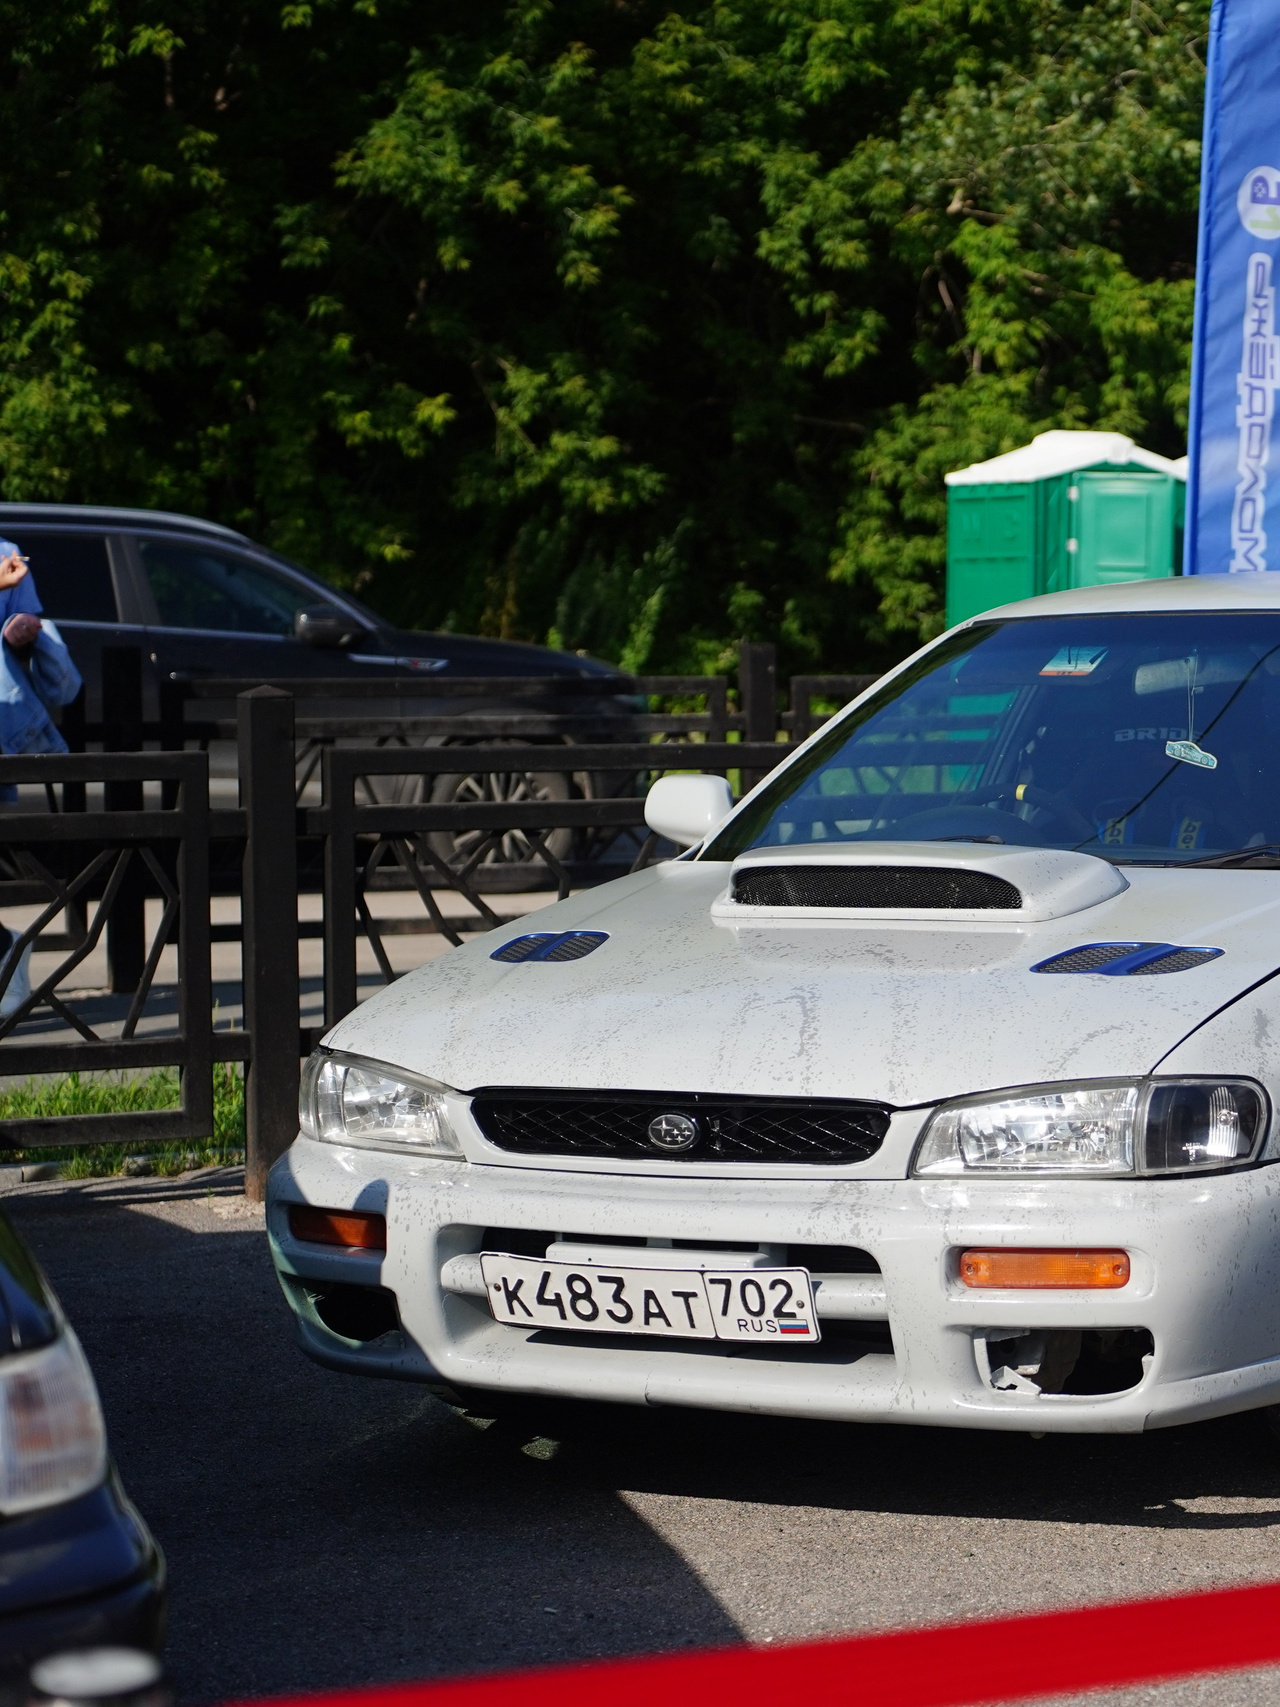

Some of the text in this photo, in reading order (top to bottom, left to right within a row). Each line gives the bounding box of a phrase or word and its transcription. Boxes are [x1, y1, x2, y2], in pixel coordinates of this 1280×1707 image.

[501, 1270, 797, 1329] К483АТ 702
[737, 1318, 778, 1333] RUS
